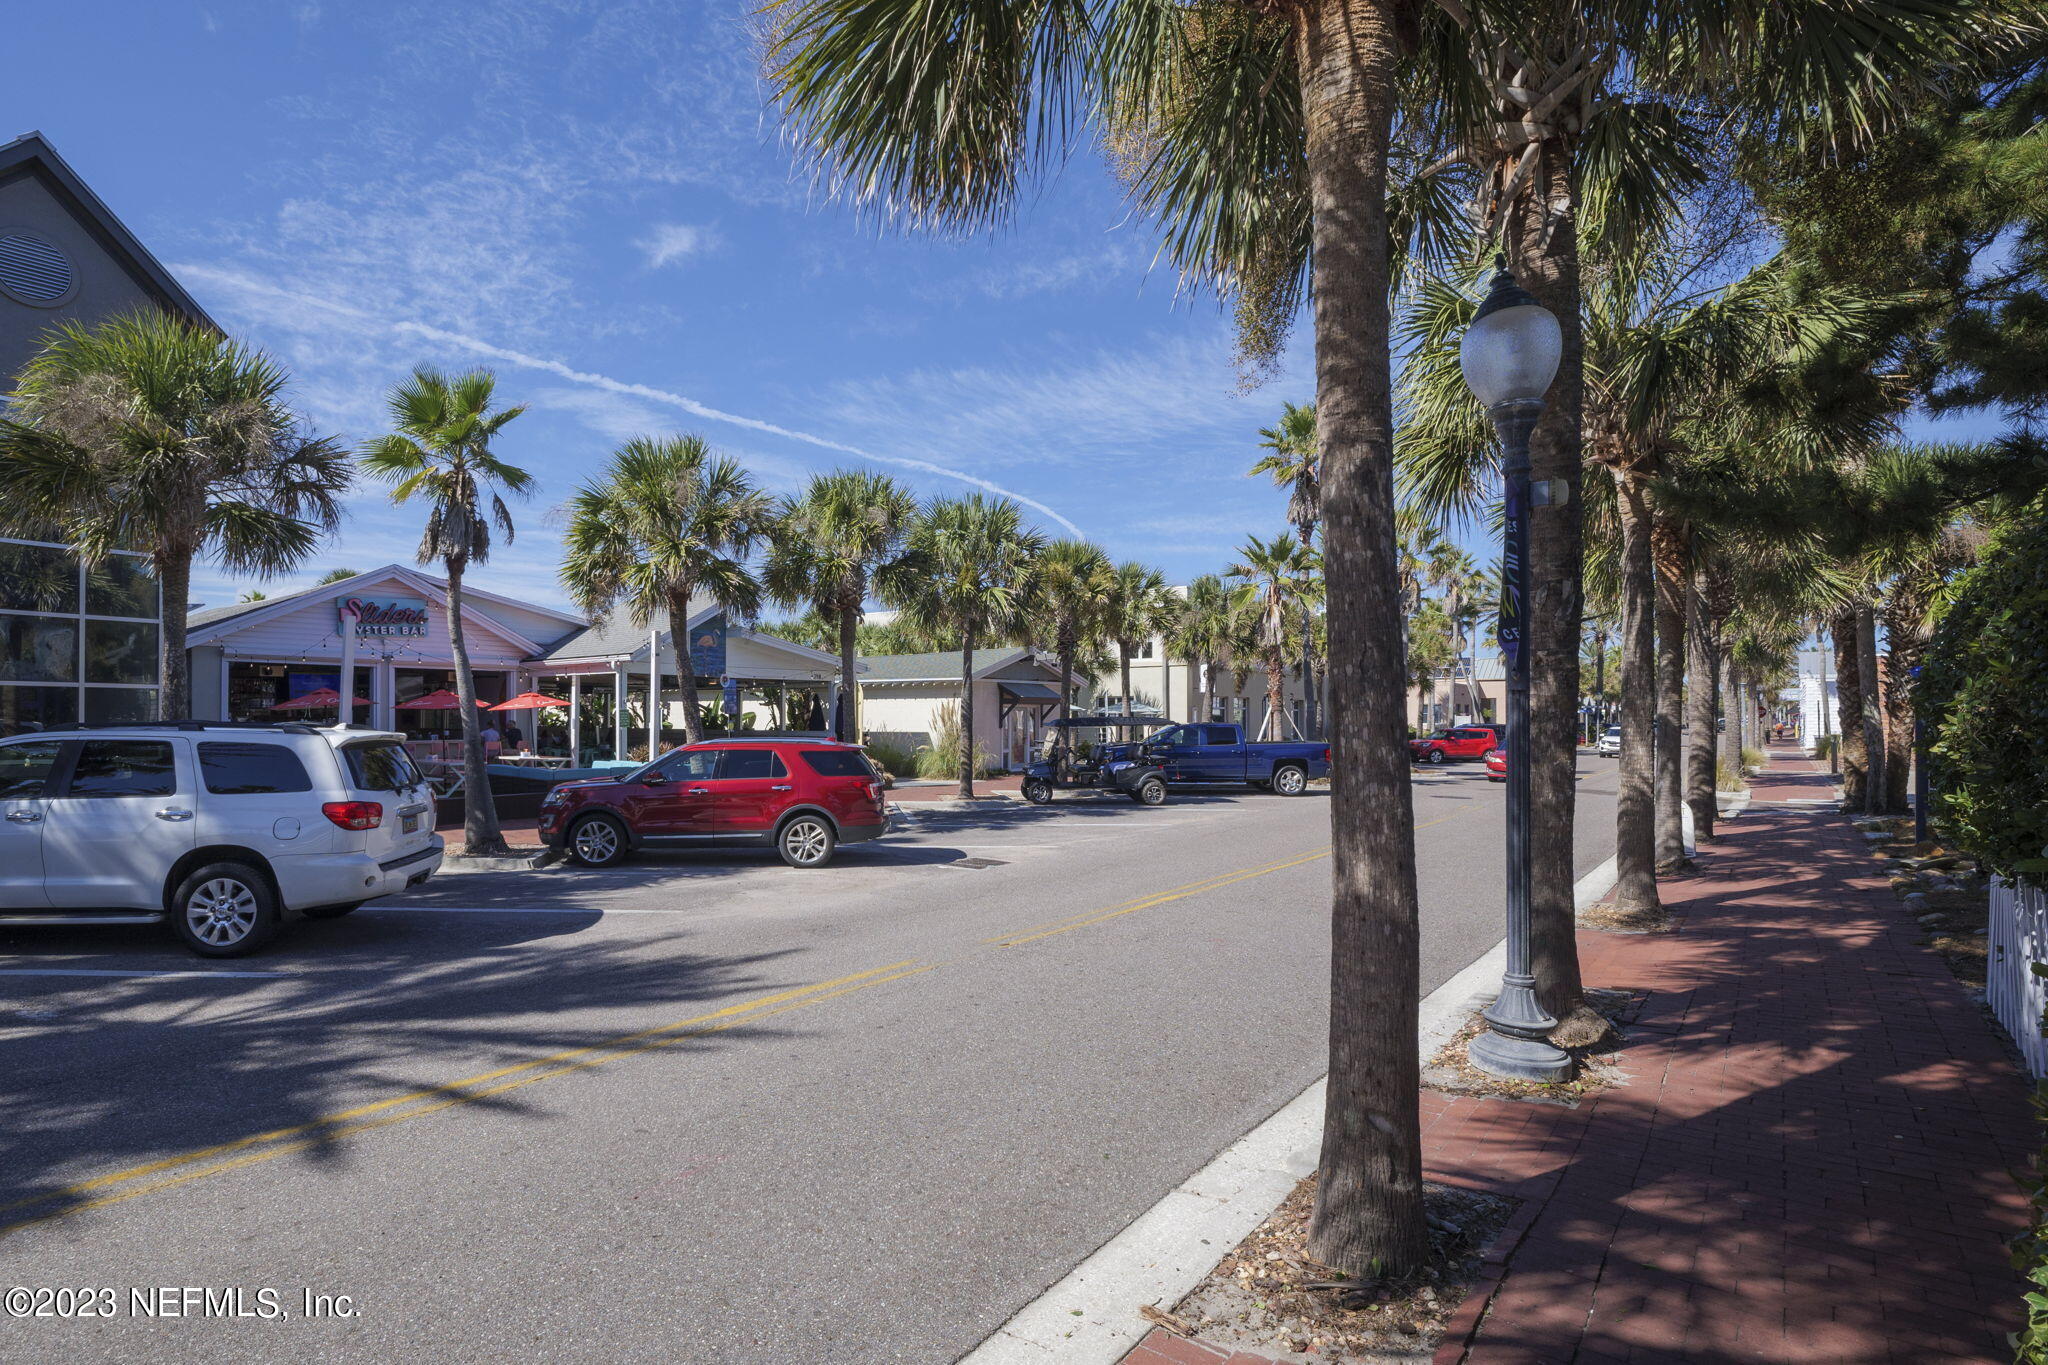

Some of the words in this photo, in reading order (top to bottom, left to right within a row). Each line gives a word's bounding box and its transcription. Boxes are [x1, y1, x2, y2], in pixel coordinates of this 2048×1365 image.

[341, 598, 429, 625] Sliders
[355, 626, 396, 635] YSTER
[402, 626, 426, 635] BAR
